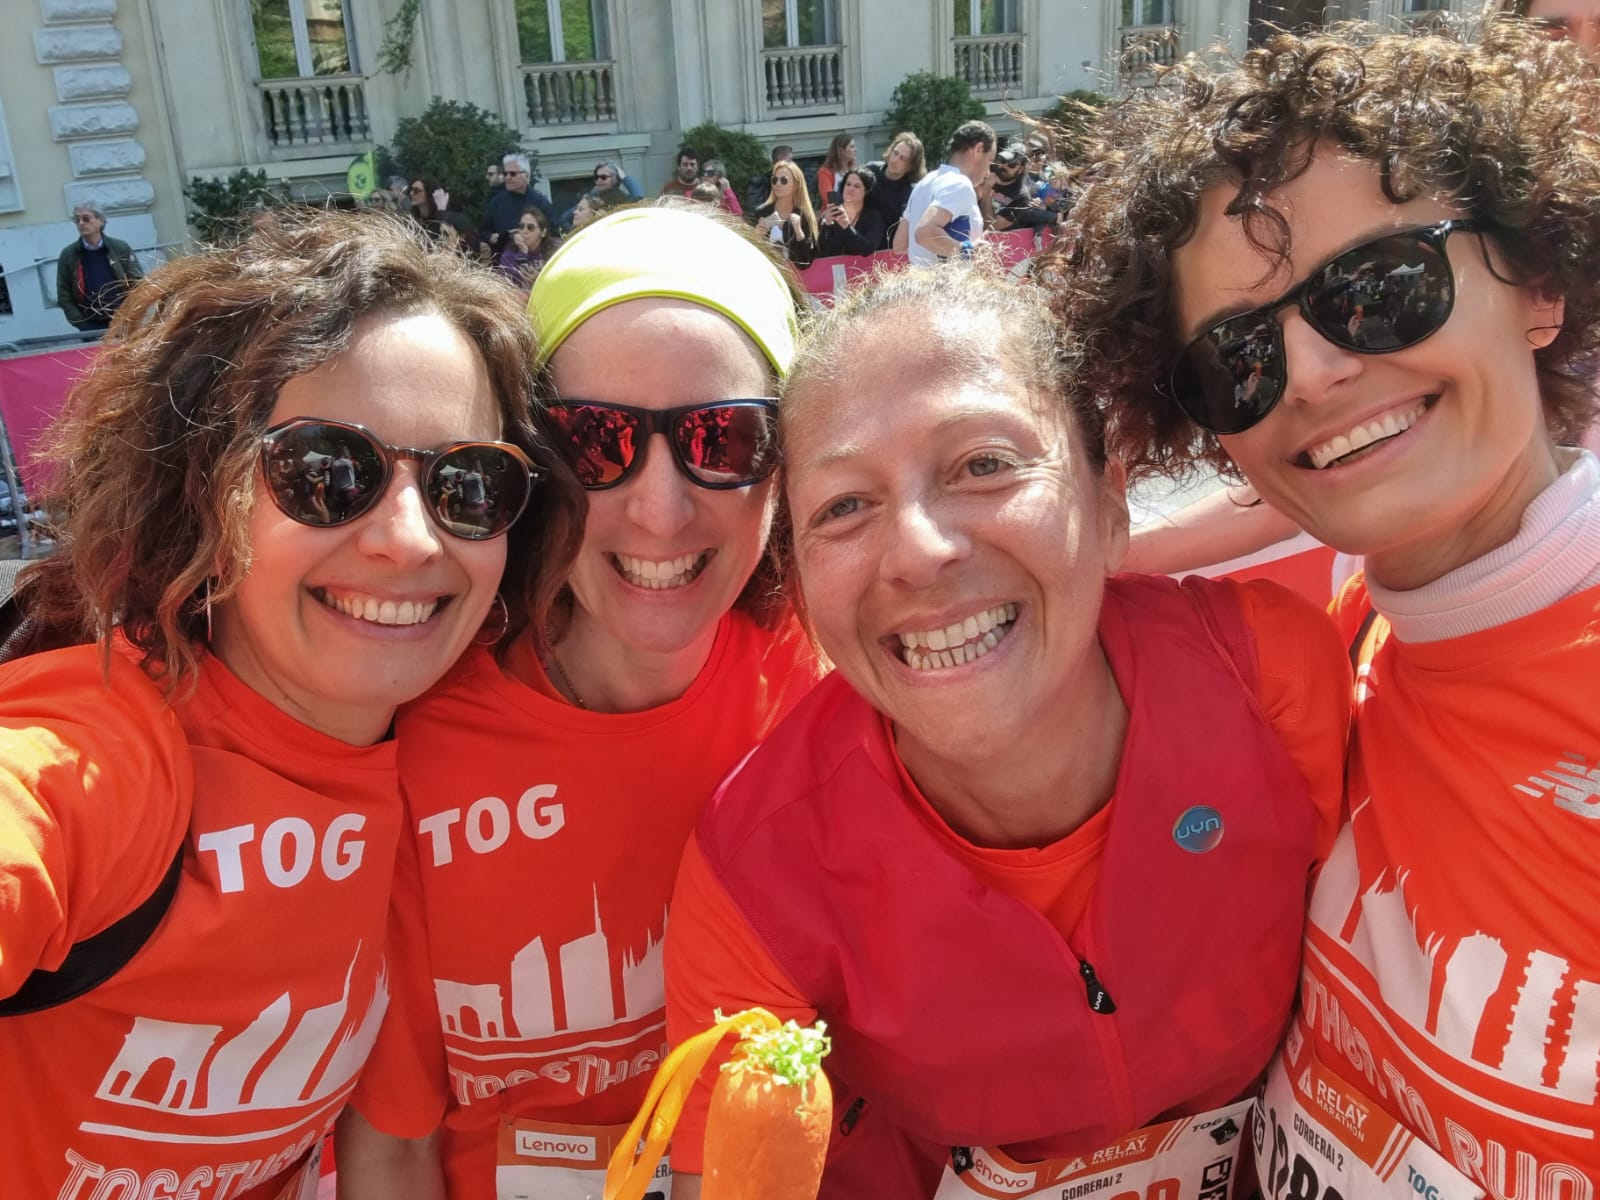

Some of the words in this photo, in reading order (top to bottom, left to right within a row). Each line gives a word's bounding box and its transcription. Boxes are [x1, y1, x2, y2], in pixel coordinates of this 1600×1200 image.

[419, 784, 565, 867] TOG
[199, 813, 366, 894] TOG
[1316, 1096, 1365, 1143] MARATHON
[1317, 1078, 1368, 1129] RELAY
[522, 1136, 589, 1154] Lenovo
[1091, 1148, 1147, 1166] MARATHON
[1093, 1138, 1149, 1161] RELAY
[1294, 1112, 1336, 1165] CORRERAI
[1337, 1153, 1344, 1172] 2
[974, 1156, 1028, 1188] enovo
[1062, 1175, 1113, 1200] CORRERAI
[1115, 1172, 1123, 1184] 2
